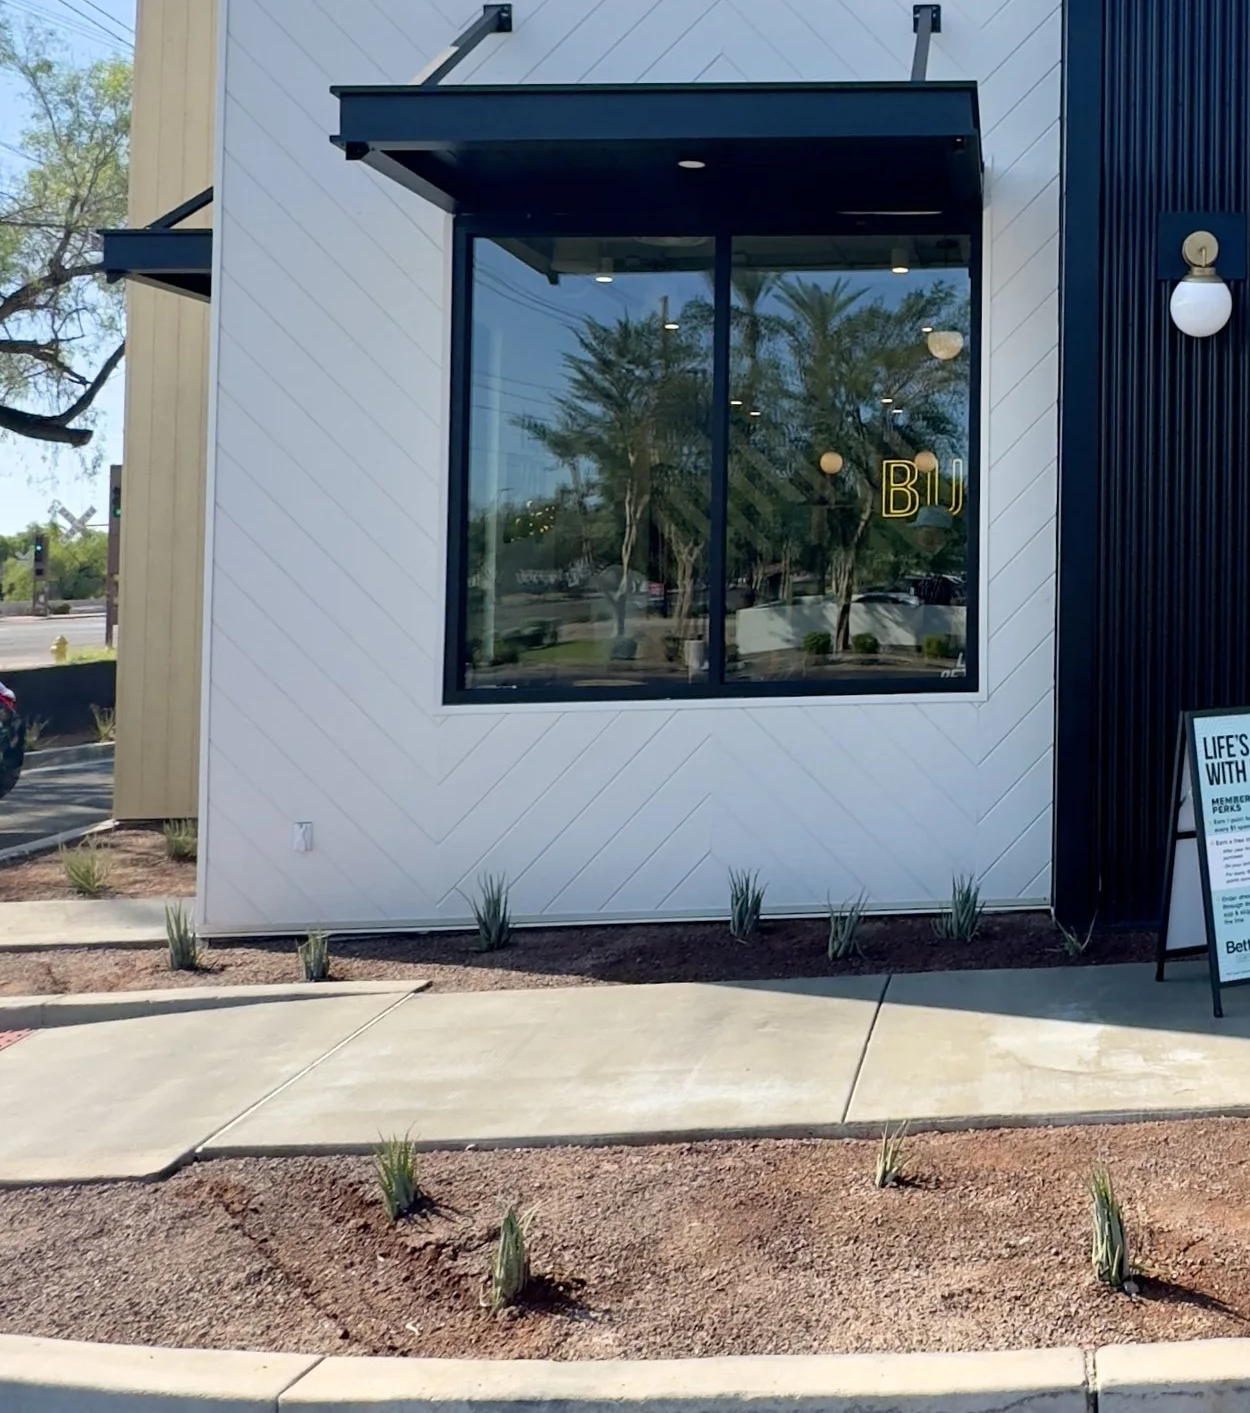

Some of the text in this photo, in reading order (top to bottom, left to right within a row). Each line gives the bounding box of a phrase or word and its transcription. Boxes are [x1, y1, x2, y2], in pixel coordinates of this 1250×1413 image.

[1203, 733, 1250, 760] LIFE'S
[1205, 759, 1247, 786] WITH
[1211, 794, 1250, 806] MEMBER
[1212, 804, 1242, 814] PERKS
